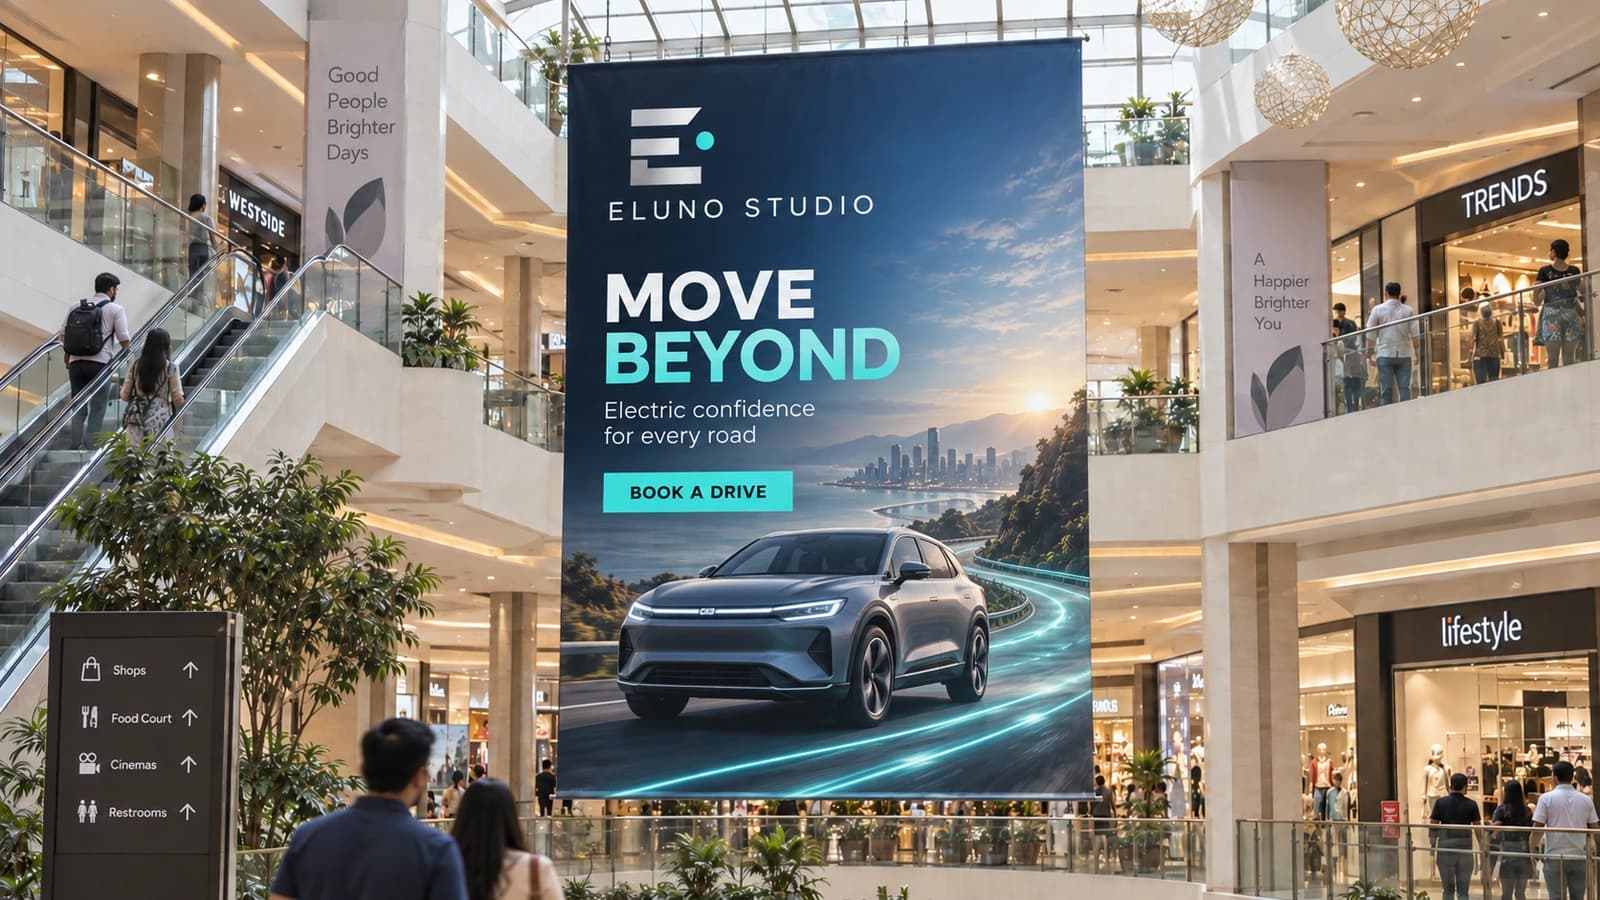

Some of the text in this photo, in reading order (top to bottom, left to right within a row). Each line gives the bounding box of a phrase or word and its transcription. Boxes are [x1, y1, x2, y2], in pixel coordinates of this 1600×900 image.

[328, 65, 379, 83] Good
[328, 91, 388, 113] People
[327, 118, 396, 139] Brighter
[327, 144, 369, 165] Days
[1461, 168, 1548, 218] TRENDS
[229, 189, 285, 238] WESTSIDE
[608, 194, 875, 222] ELUNO STUDIO
[1254, 252, 1266, 266] A
[1254, 273, 1310, 291] Happier
[605, 268, 815, 323] MOVE
[1254, 295, 1311, 312] Brighter
[1254, 316, 1282, 330] You
[605, 327, 901, 385] BEYOND
[604, 399, 816, 420] Electric confidence
[604, 425, 757, 449] for every road
[630, 484, 767, 500] BOOK A DRIVE
[1441, 610, 1523, 651] lifestyle
[113, 665, 147, 678] Shops
[111, 713, 173, 724] Food Court
[110, 760, 157, 771] Cinemas
[109, 807, 168, 818] Restrooms
